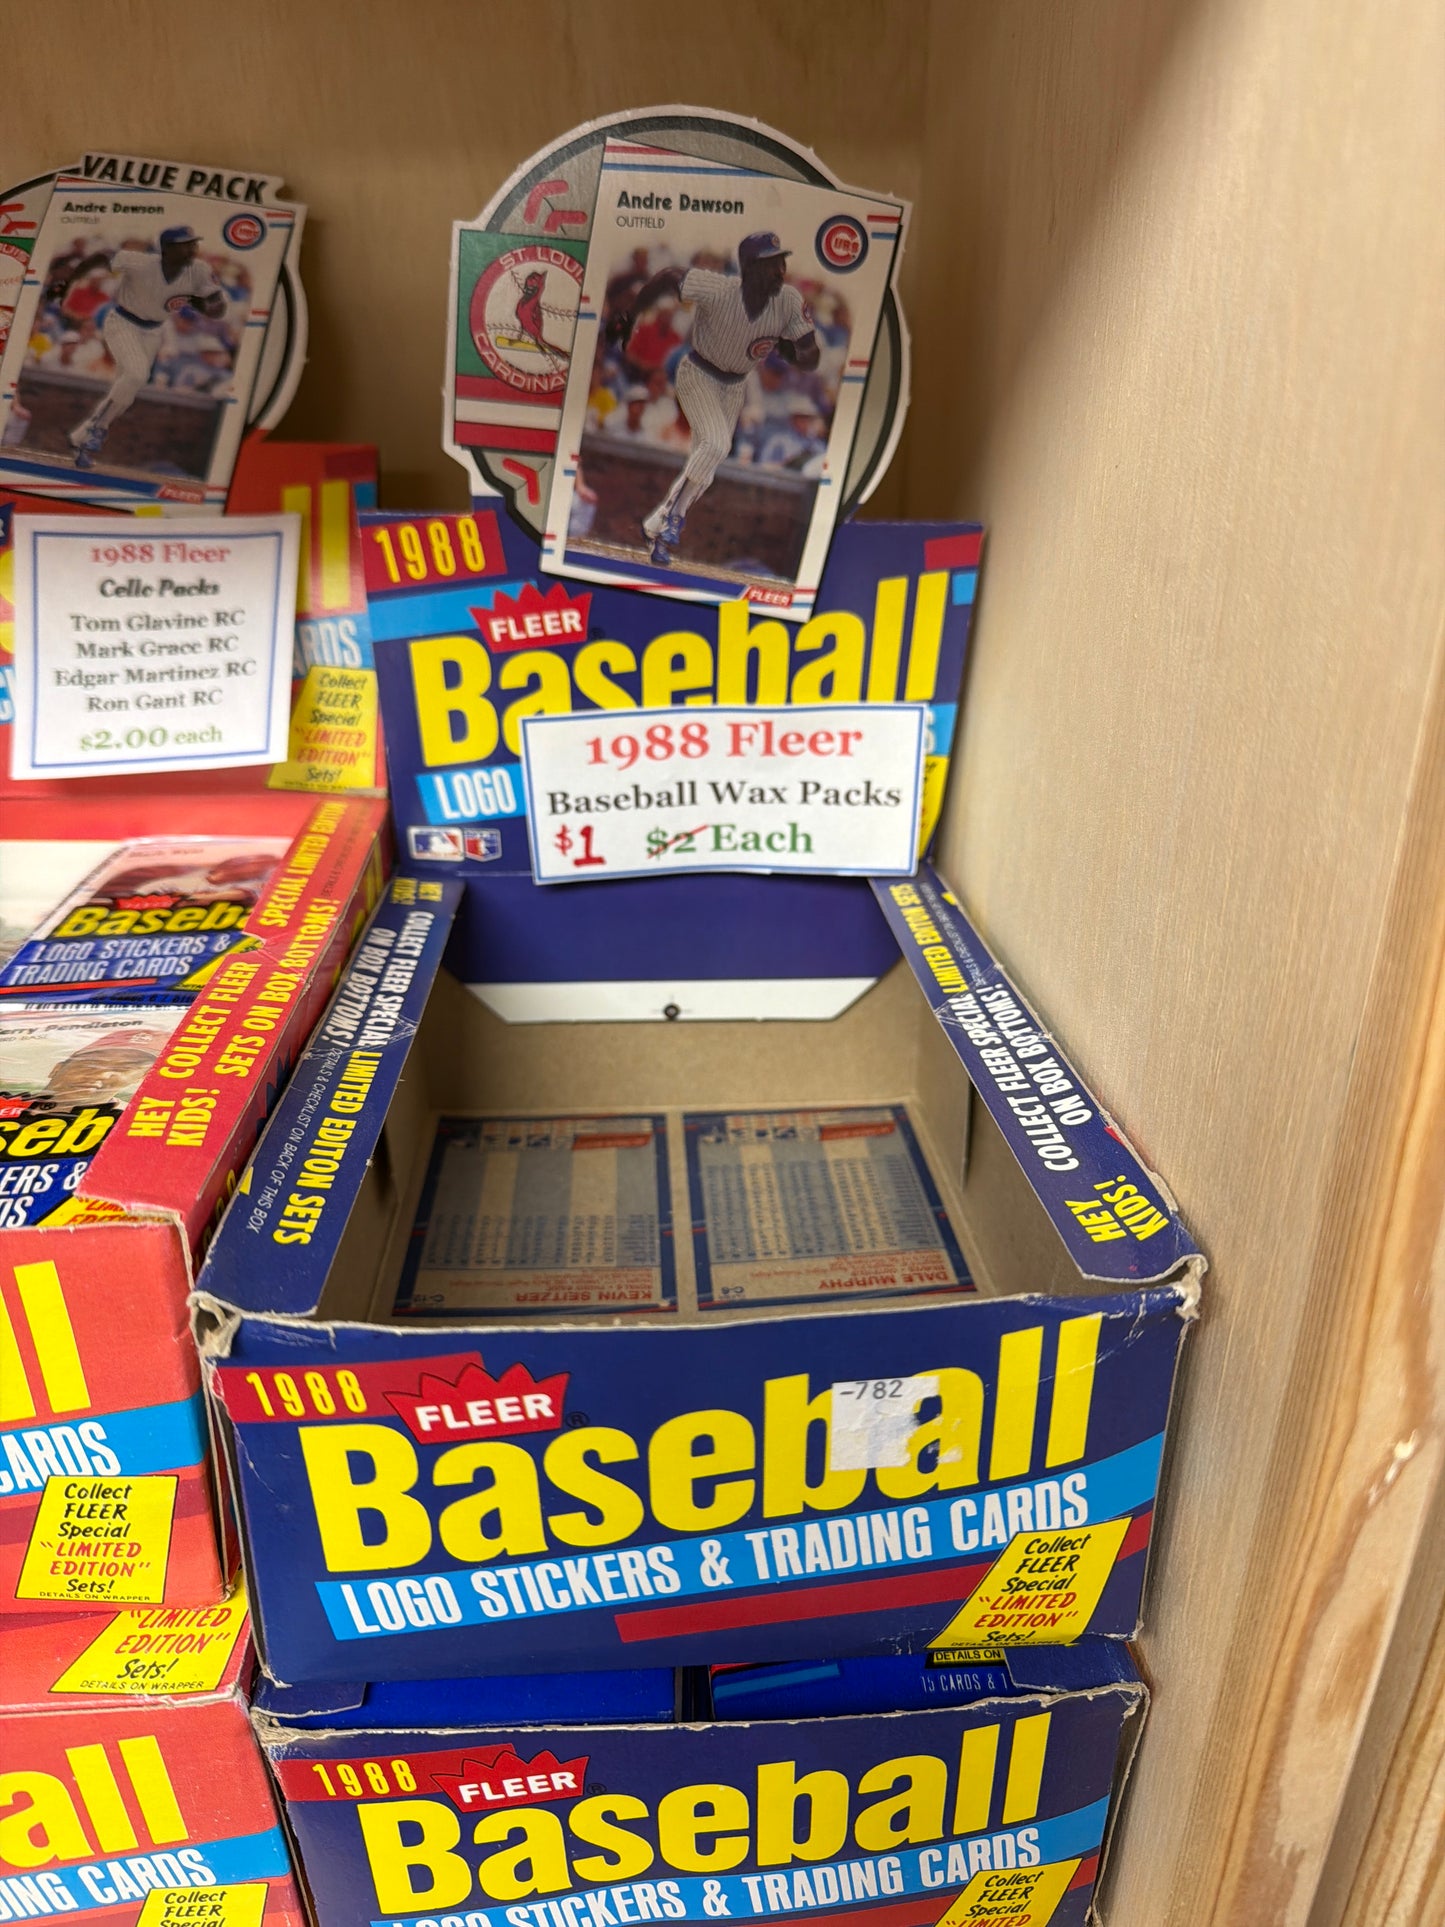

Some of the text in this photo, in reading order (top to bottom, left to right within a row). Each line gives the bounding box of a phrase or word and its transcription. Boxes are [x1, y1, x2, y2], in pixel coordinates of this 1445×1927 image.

[83, 154, 268, 204] VALUE PACK
[63, 201, 164, 215] Andre Dawson
[617, 191, 744, 215] Andre Dawson
[616, 216, 666, 230] OUTFIELD
[475, 332, 568, 392] CARDINA
[89, 542, 231, 567] 1988 Fleer
[373, 517, 486, 584] 1988
[99, 578, 221, 599] Cello Packs
[749, 588, 790, 606] FLEER
[70, 609, 246, 632] Tom Glavine RC
[488, 609, 583, 643] FLEER
[76, 636, 239, 660] Mark Grace RC
[54, 660, 257, 690] Edgar Martinez RC
[318, 673, 368, 690] Collect
[408, 571, 950, 768] Baseball
[87, 688, 224, 714] Ron Gant RC
[316, 691, 362, 709] FLEER
[310, 709, 362, 727] Special
[79, 724, 224, 752] $2.00 each
[585, 720, 864, 771] 1988 Fleer
[433, 768, 517, 821] LOGO
[547, 780, 902, 816] Baseball Wax Packs
[554, 824, 607, 867] $1
[645, 821, 814, 860] $2 Each
[33, 934, 232, 962] LOGO STICKERS &
[367, 927, 398, 948] ON
[395, 911, 436, 958] COLLECT
[9, 956, 194, 986] TRADING CARDS
[355, 945, 390, 974] BOX
[922, 945, 969, 994] LIMITED
[159, 1005, 232, 1079] COLLECT
[208, 962, 262, 1002] FLEER
[258, 877, 309, 928] SPECIAL
[214, 898, 341, 1078] SETS ON BOX BOTTOMS!
[379, 957, 419, 994] FLEER
[321, 972, 379, 1048] BOTTOMS!
[357, 993, 405, 1048] SPECIAL
[948, 993, 1003, 1046] SPECIAL
[975, 983, 1049, 1059] BOTTOMS!
[329, 1050, 383, 1114] LIMITED
[979, 1045, 1031, 1092] FLEER
[1025, 1056, 1074, 1096] BOX
[127, 1096, 176, 1137] HEY
[166, 1087, 221, 1147] KIDS!
[298, 1082, 327, 1128] CHECKLIST
[1048, 1094, 1093, 1126] ON
[289, 1127, 305, 1142] ON
[1006, 1095, 1080, 1172] COLLECT
[276, 1141, 298, 1171] BACK
[269, 1169, 286, 1187] OF
[258, 1184, 279, 1210] THIS
[1093, 1174, 1169, 1242] KIDS!
[246, 1209, 269, 1235] BOX
[273, 1192, 326, 1245] SETS
[1064, 1199, 1127, 1244] HEY
[817, 1269, 949, 1290] DALE MURPHY
[515, 1290, 653, 1304] KEVIN SEITZER
[246, 1369, 369, 1418] 1988
[414, 1392, 556, 1433] FLEER
[298, 1311, 1103, 1573] Baseball
[64, 1482, 133, 1500] Collect
[64, 1503, 128, 1520] FLEER
[57, 1522, 132, 1540] Special
[1024, 1533, 1092, 1556] Collect
[340, 1473, 1089, 1635] LOGO STICKERS & TRADING CARDS
[1015, 1554, 1081, 1574] FLEER
[39, 1591, 81, 1599] DETAILS
[66, 1579, 115, 1594] Sets!
[1001, 1573, 1077, 1594] Special
[981, 1630, 1036, 1643] Sets!
[117, 1657, 180, 1680] Sets!
[935, 1650, 1001, 1661] DETAILS ON
[80, 1679, 205, 1691] DETAILS ON WRAPPER
[940, 1674, 981, 1692] CARDS
[987, 1673, 996, 1690] &
[311, 1758, 418, 1798] 1988
[457, 1770, 579, 1804] FLEER
[356, 1711, 1052, 1915] Baseball
[77, 1848, 217, 1905] CARDS
[504, 1827, 1042, 1927] STICKERS & TRADING CARDS
[984, 1870, 1045, 1888] Collect
[164, 1890, 228, 1905] Collect
[965, 1900, 1033, 1919] Special
[977, 1886, 1035, 1903] FLEER
[164, 1904, 223, 1918] FLEER
